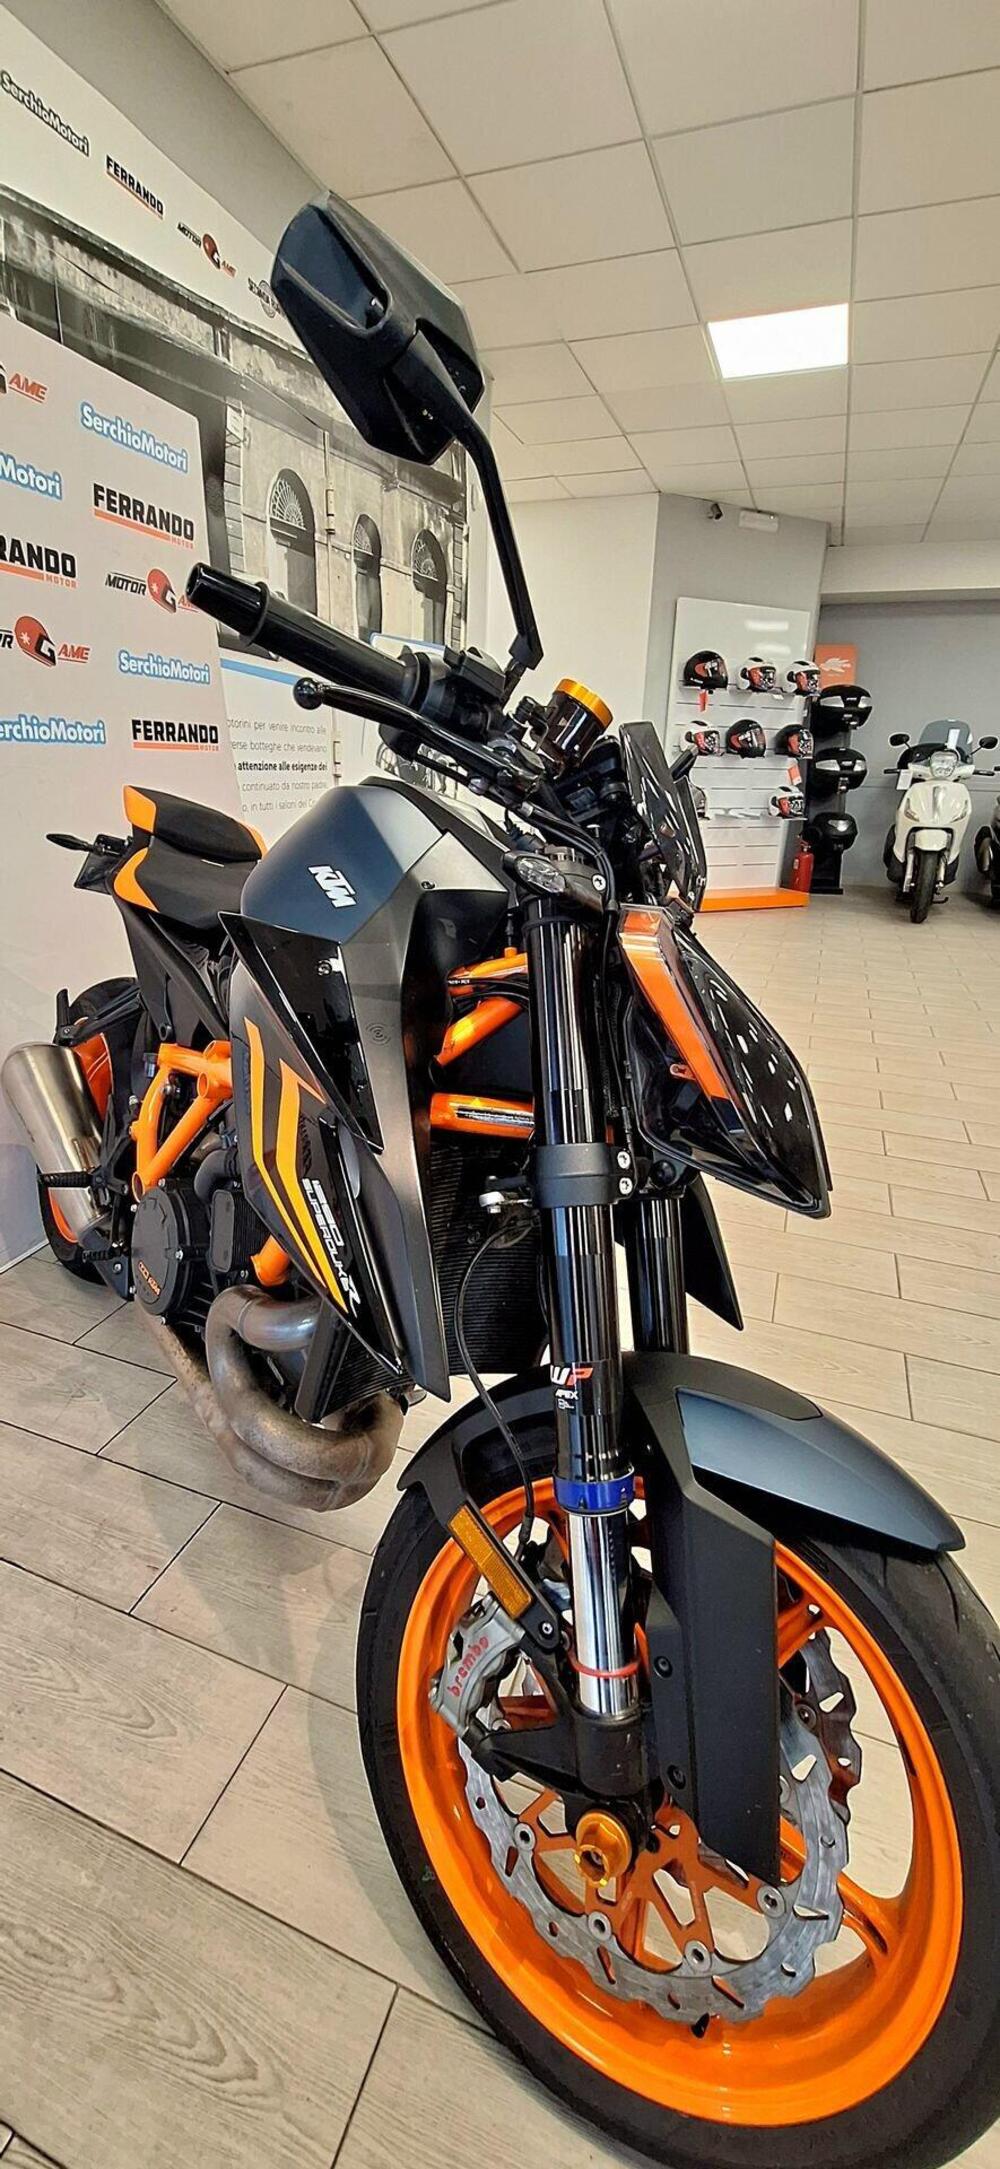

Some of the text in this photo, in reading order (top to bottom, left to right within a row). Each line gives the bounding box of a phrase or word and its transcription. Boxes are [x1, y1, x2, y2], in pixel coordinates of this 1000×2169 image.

[1, 70, 89, 157] SerchioMotori
[106, 154, 164, 216] FERRANDO
[177, 221, 202, 248] MOTOR
[80, 402, 188, 473] SerchioMotori
[0, 452, 62, 500] Motori
[93, 483, 194, 541] FERRANDO
[45, 574, 77, 588] MOTOR
[104, 573, 147, 596] MOTOR
[118, 650, 210, 685] SerchioMotori
[131, 719, 219, 744] FERRANDO
[237, 760, 278, 771] attenzione
[278, 761, 290, 771] alle
[291, 762, 317, 773] esigenze
[308, 865, 357, 908] KTM
[446, 1634, 490, 1698] brembo
